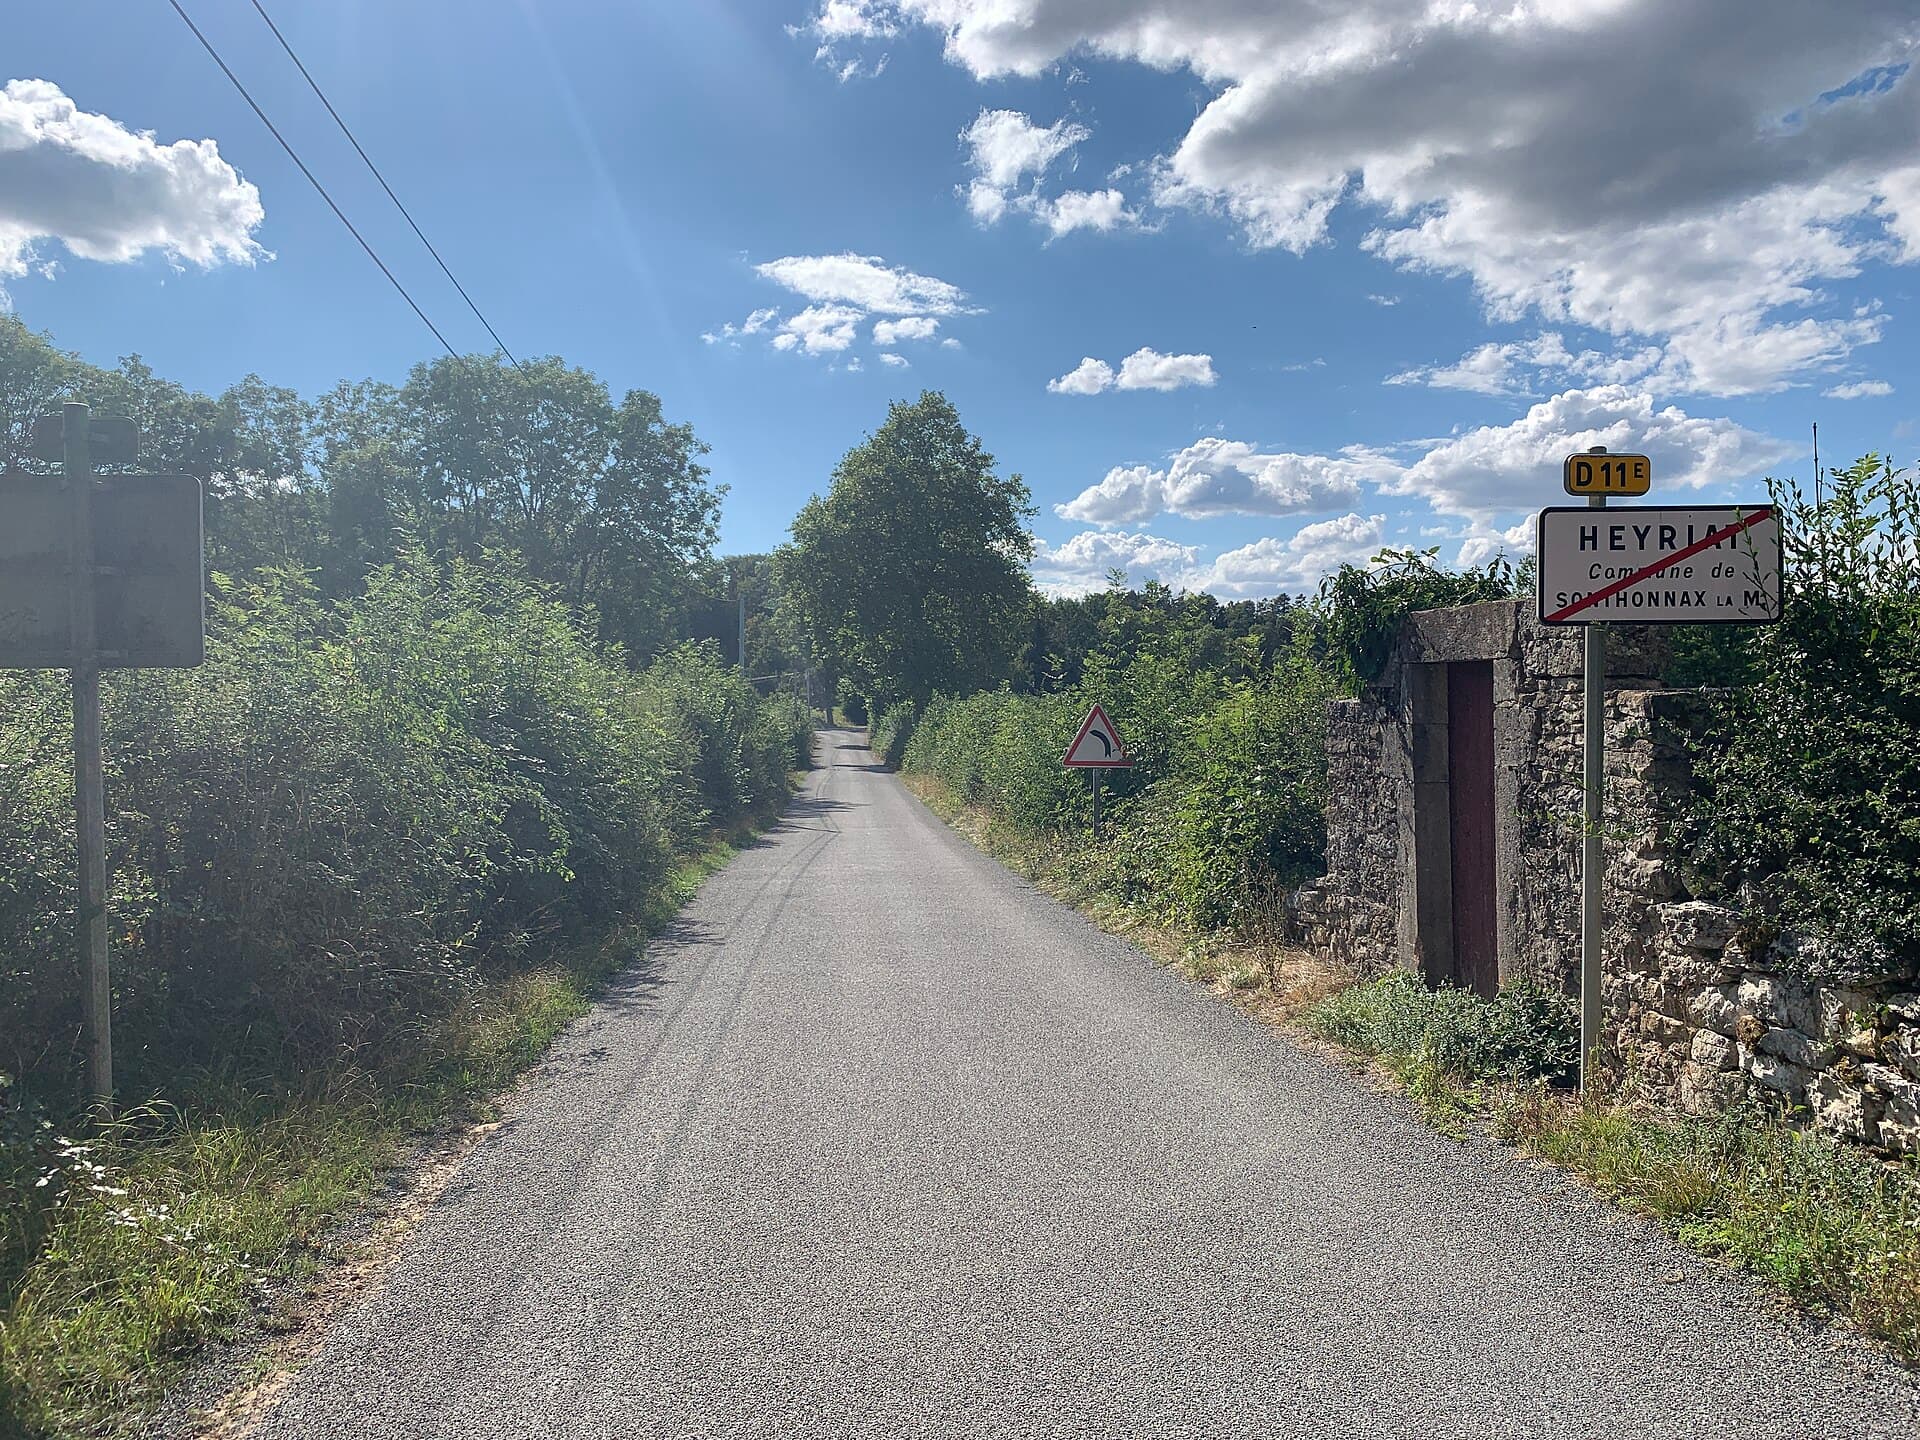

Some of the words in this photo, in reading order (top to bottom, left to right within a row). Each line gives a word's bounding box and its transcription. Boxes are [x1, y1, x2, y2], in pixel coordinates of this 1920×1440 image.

[1575, 461, 1593, 487] D
[1589, 562, 1694, 580] Comune
[1711, 562, 1735, 579] de
[1717, 596, 1733, 607] LA
